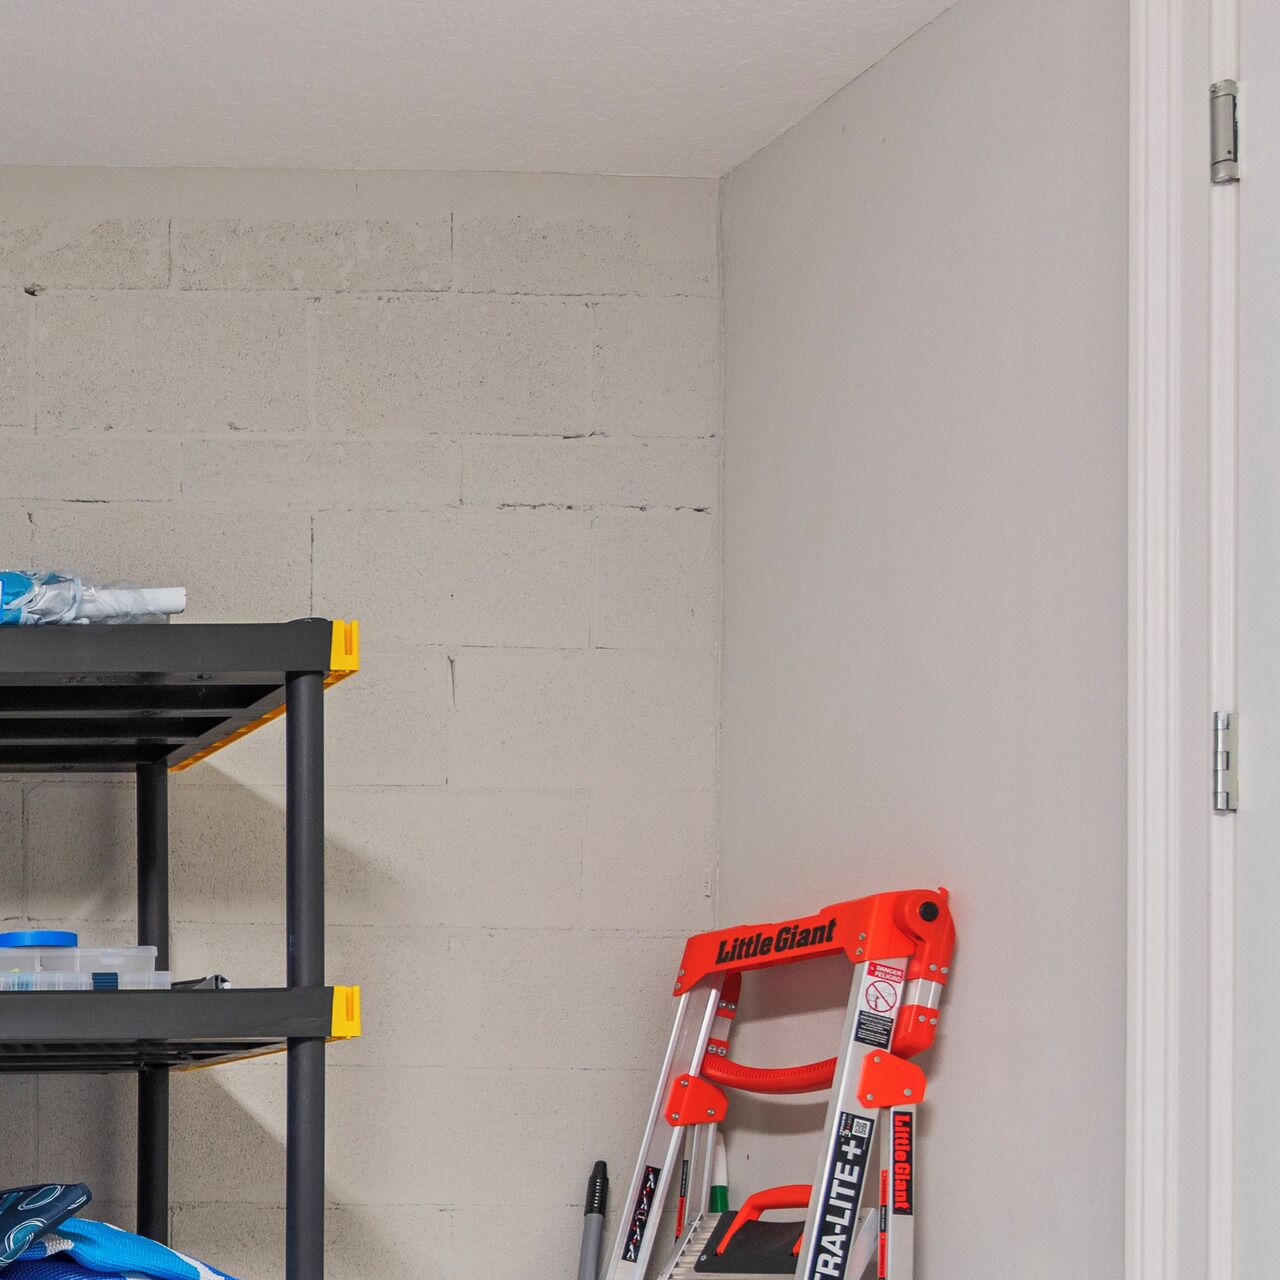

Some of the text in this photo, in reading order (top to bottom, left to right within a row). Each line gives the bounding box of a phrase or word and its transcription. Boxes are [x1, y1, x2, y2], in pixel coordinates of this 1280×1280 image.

[715, 918, 836, 965] Little Giant
[875, 965, 903, 976] DANGER
[874, 971, 901, 982] PELIGRO
